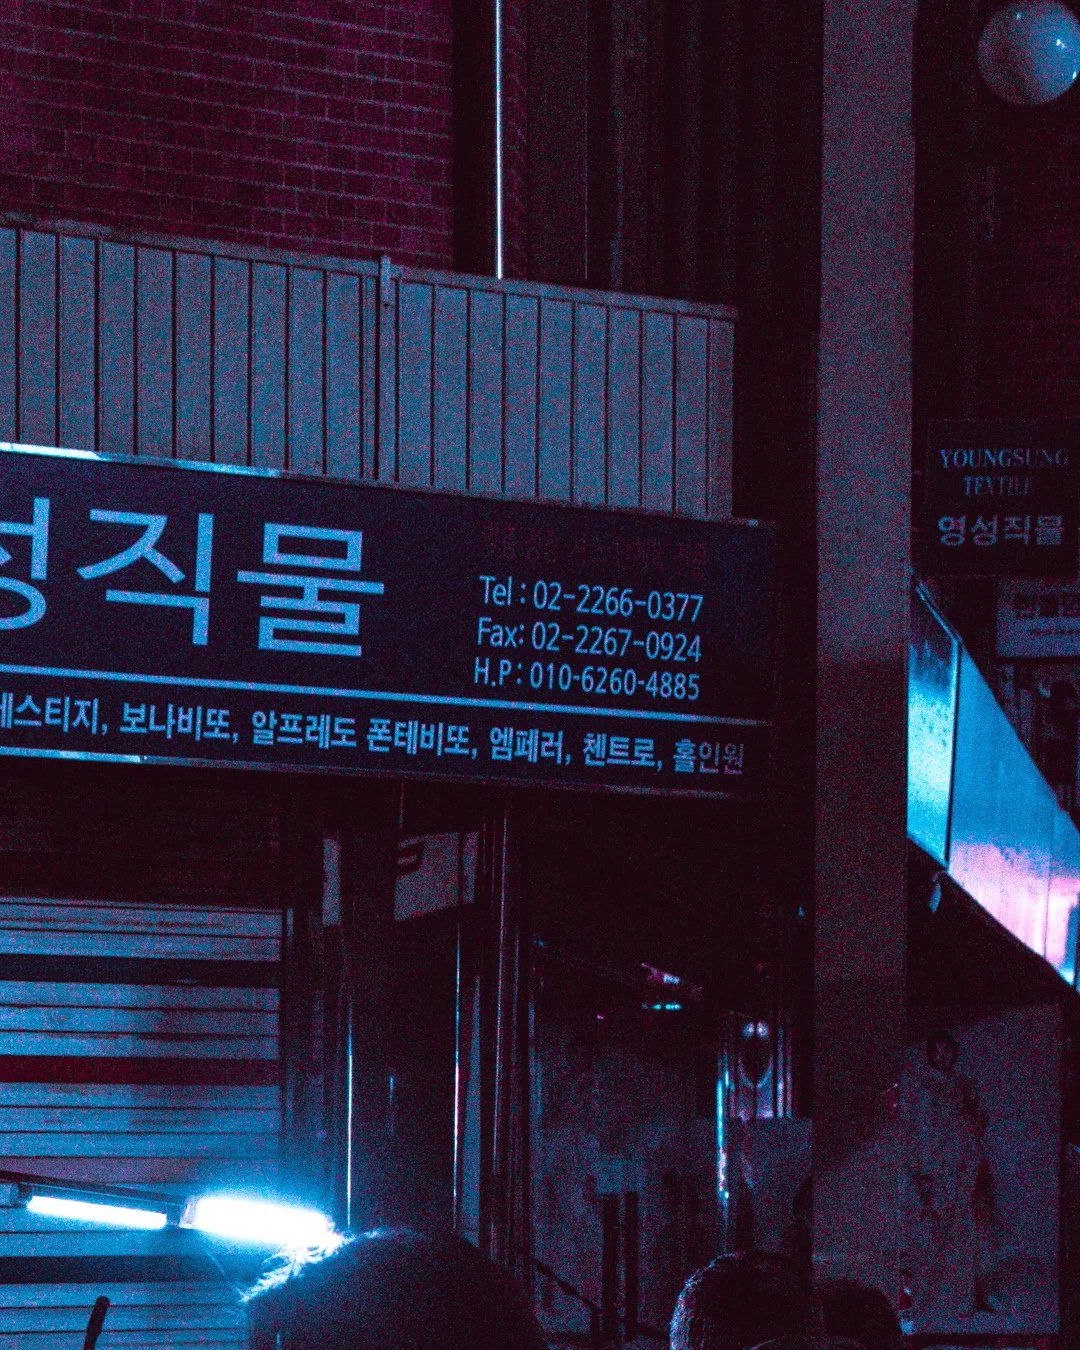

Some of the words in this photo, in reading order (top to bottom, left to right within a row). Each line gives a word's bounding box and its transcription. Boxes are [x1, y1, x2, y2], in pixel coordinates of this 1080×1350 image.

[936, 514, 1065, 546] 영성직물
[532, 579, 704, 623] 02-2266-0377
[531, 620, 702, 662] 02-2267-0924
[529, 660, 700, 701] 010-6260-4885
[120, 702, 239, 744] 보나비또,
[251, 710, 357, 750] 알프레도
[366, 717, 478, 759] 폰테비또,
[489, 726, 572, 765] 엠페러,
[672, 738, 745, 775] 홀인원
